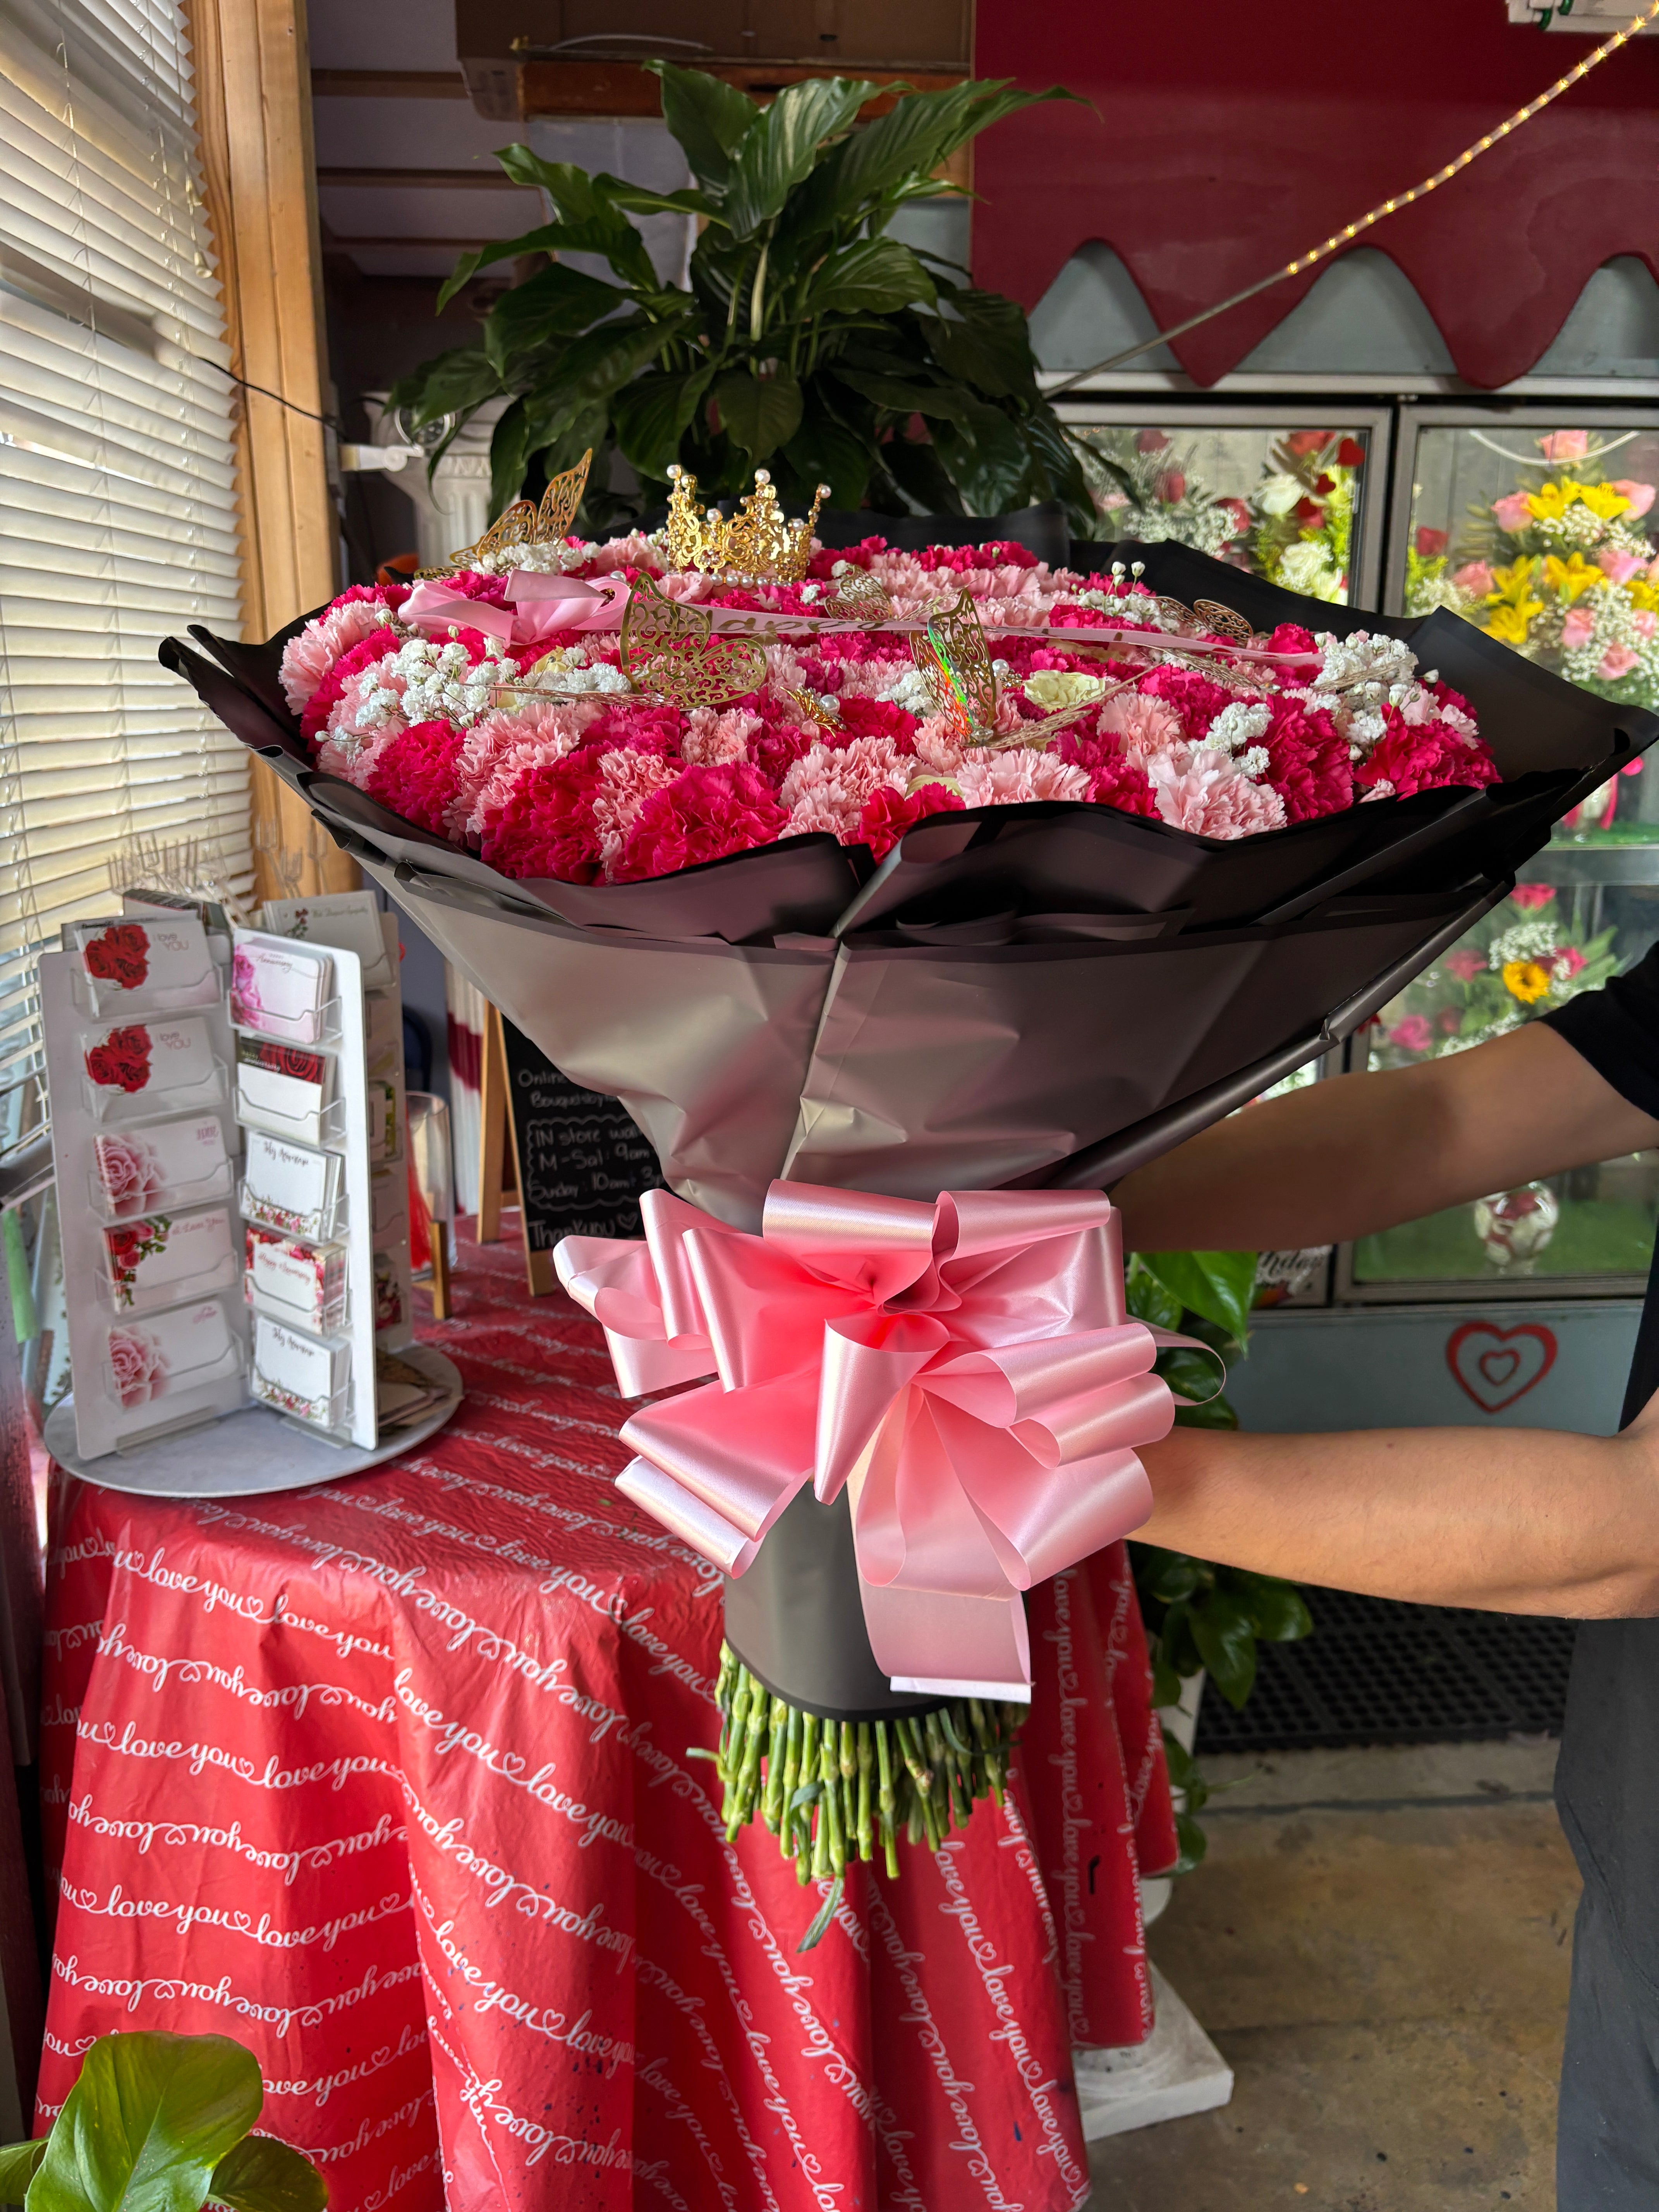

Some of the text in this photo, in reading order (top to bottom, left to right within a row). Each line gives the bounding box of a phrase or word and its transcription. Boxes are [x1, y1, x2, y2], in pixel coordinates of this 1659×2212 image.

[163, 940, 189, 951] YOU
[165, 1037, 191, 1050] YOU
[536, 1128, 554, 1147] IN
[148, 1547, 394, 1661] love you love you
[539, 1565, 605, 1601] you
[648, 1654, 704, 1695] you
[125, 1644, 398, 1724] you love you love
[117, 1720, 186, 1759] love
[186, 1741, 237, 1776] you
[261, 1755, 327, 1789] love
[325, 1755, 393, 1790] you
[394, 1667, 449, 1731] love
[434, 1722, 501, 1756] you
[526, 1762, 598, 1822] love
[91, 1820, 156, 1855] love
[192, 1820, 248, 1854] you
[335, 1813, 392, 1858] you
[245, 1844, 301, 1886] love
[455, 1841, 515, 1908] love
[723, 1850, 756, 1909] love
[106, 1884, 177, 1918] love
[176, 1904, 236, 1935] you
[258, 1912, 319, 1948] love
[315, 1908, 380, 1953] you
[544, 1903, 604, 1941] you
[938, 1897, 984, 1949] you
[763, 1929, 814, 1994] you
[77, 1973, 145, 2012] love
[181, 1975, 235, 2007] you
[436, 1920, 486, 1986] love
[475, 1980, 537, 2028] you
[566, 2009, 613, 2060] love
[982, 1965, 1015, 2020] love
[232, 1996, 296, 2038] love
[793, 2001, 835, 2057] love
[989, 2021, 1032, 2069] you
[261, 2061, 373, 2107] ove you
[746, 2031, 780, 2090] love
[764, 2096, 806, 2150] you
[930, 2052, 975, 2095] you
[948, 2099, 982, 2151] love
[1030, 2079, 1058, 2132] love
[494, 2103, 560, 2166] love
[1036, 2132, 1076, 2174] you
